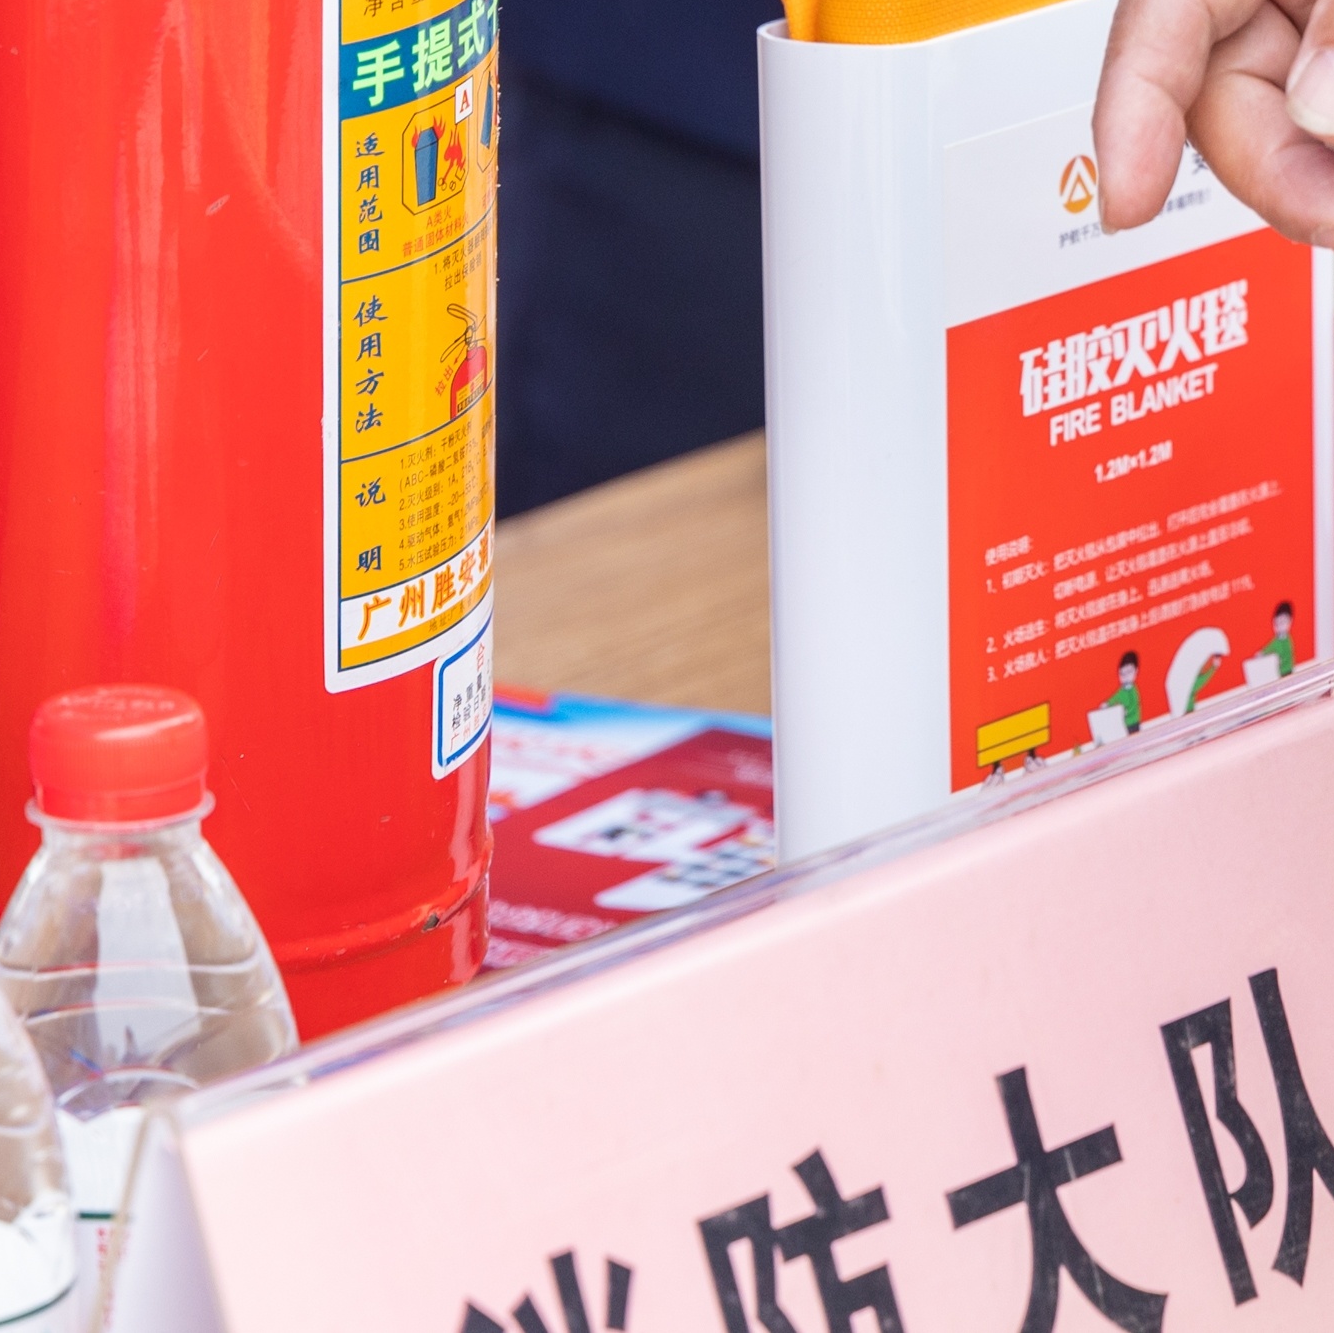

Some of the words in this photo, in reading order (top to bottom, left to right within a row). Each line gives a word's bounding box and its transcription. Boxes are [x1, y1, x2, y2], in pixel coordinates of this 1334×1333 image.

[458, 89, 471, 113] A
[354, 132, 385, 254] 适用范围
[353, 300, 387, 434] 使用方法
[1019, 278, 1248, 417] 硅胶灭火毯
[1049, 402, 1102, 447] FIRE
[1110, 362, 1218, 426] BLANKET
[357, 529, 494, 641] 广州胜安消
